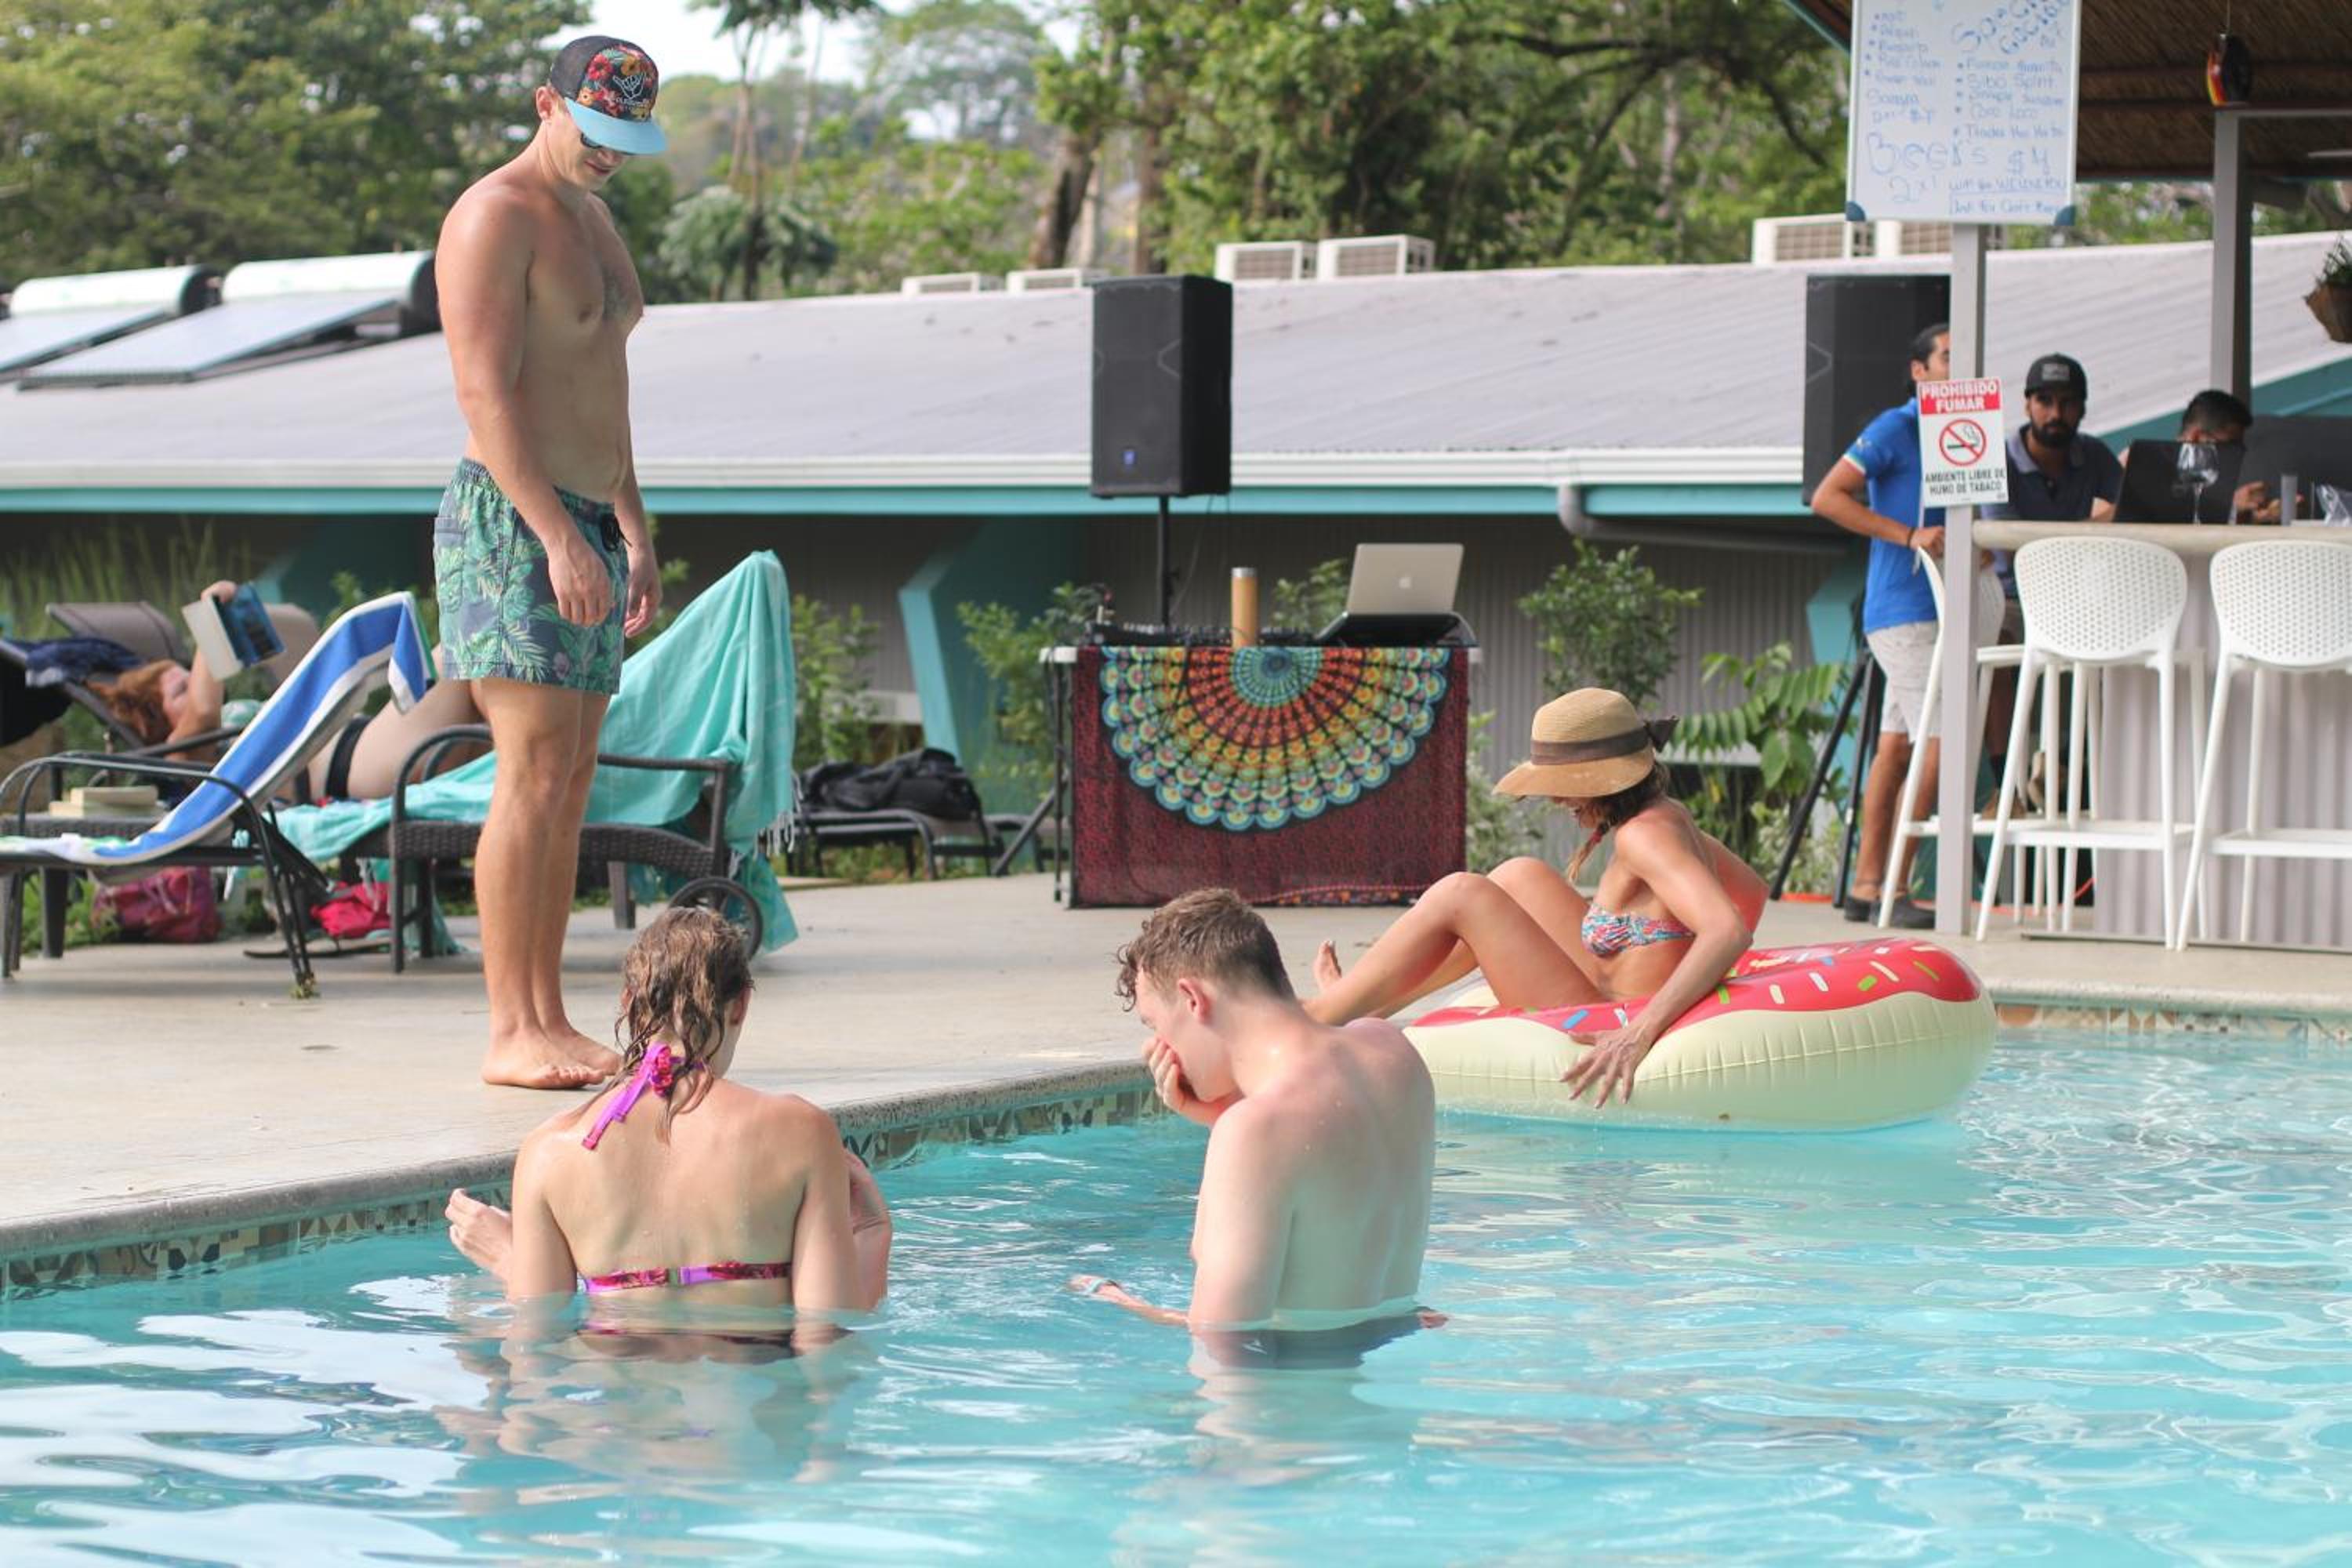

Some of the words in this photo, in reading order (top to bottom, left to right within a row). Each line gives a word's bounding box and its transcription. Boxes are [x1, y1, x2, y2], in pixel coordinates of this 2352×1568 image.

[1922, 380, 1997, 400] PROHIBIDO
[1936, 397, 1985, 412] FUMAR
[1926, 470, 1966, 482] AMBIENTE
[1969, 468, 1992, 480] LIBRE
[1994, 467, 2008, 479] DE
[1929, 483, 1955, 495] HUMO
[1956, 483, 1967, 493] DE
[1969, 481, 2002, 492] TABACO
